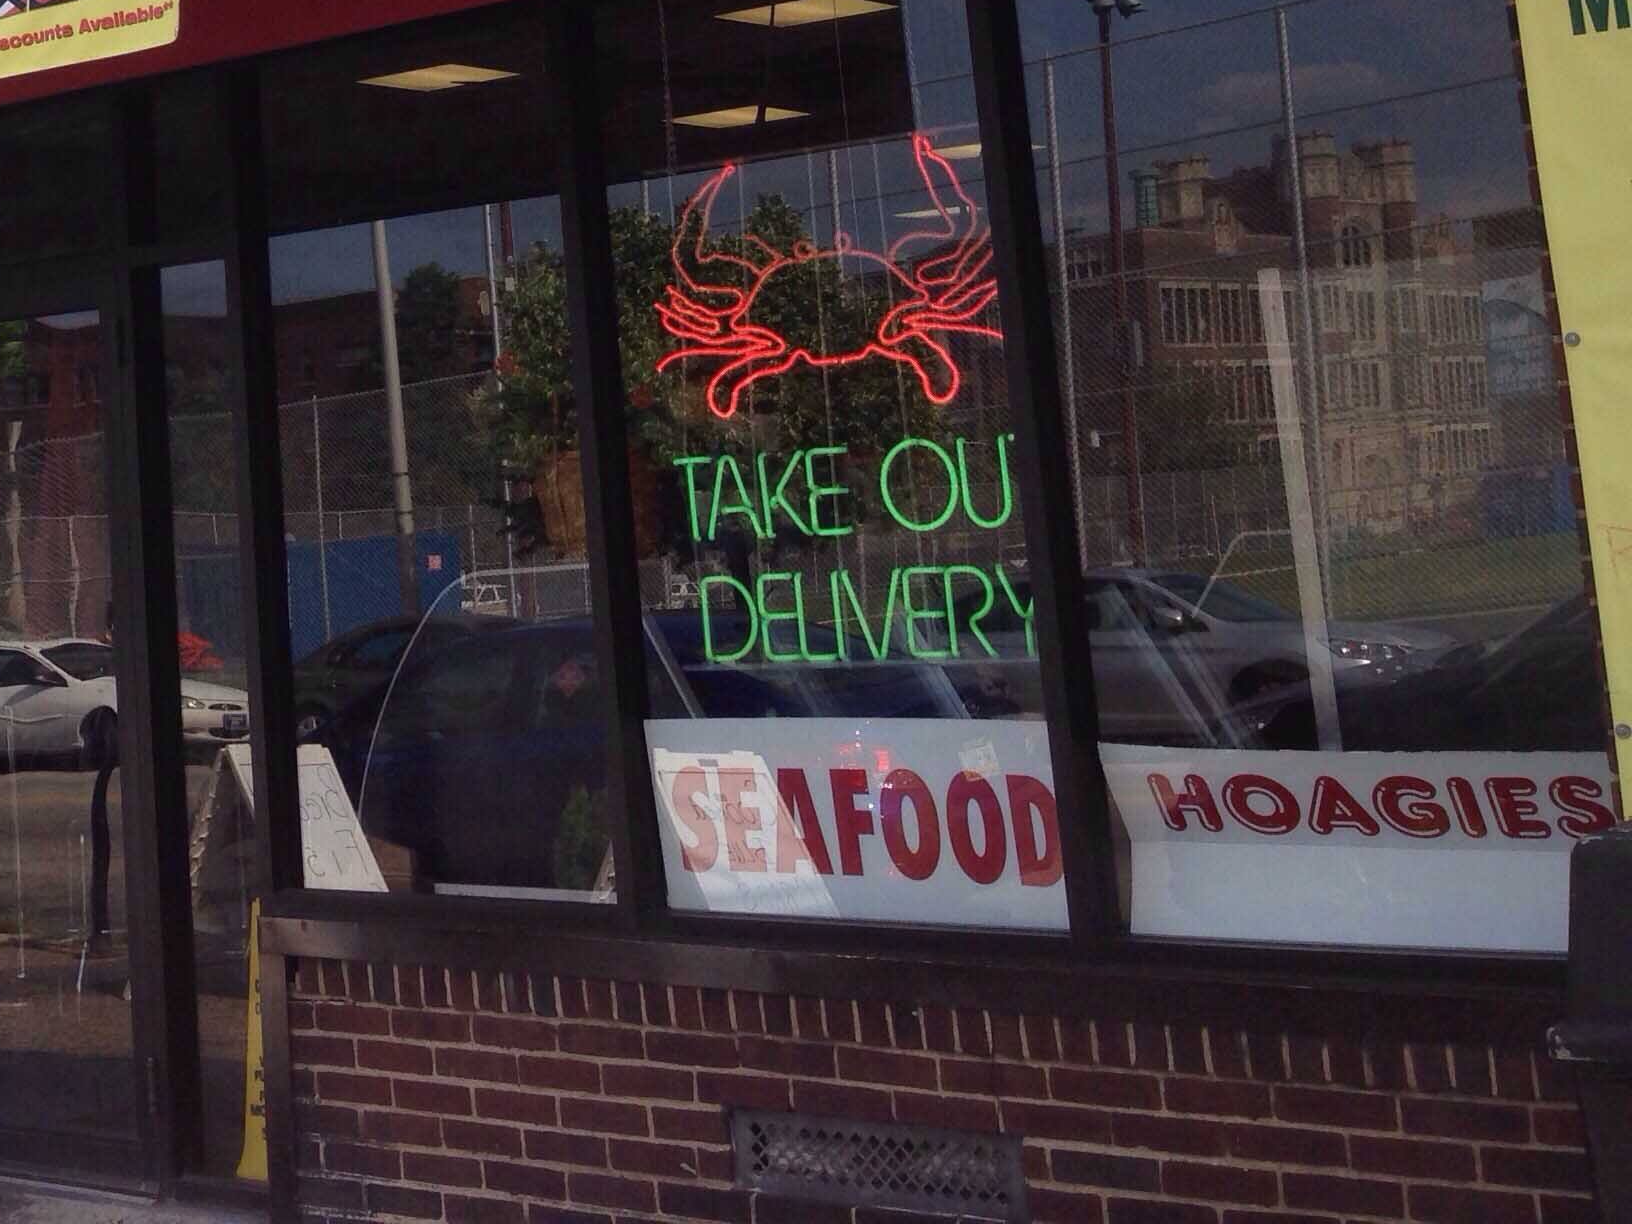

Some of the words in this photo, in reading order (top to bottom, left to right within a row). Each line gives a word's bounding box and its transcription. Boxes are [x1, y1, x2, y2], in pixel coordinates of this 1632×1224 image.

[672, 442, 854, 543] TAKE
[880, 433, 1015, 531] OU
[699, 564, 1036, 664] DELIVERY
[671, 765, 1065, 888] SEAFOOD
[1146, 773, 1619, 839] HOAGIES
